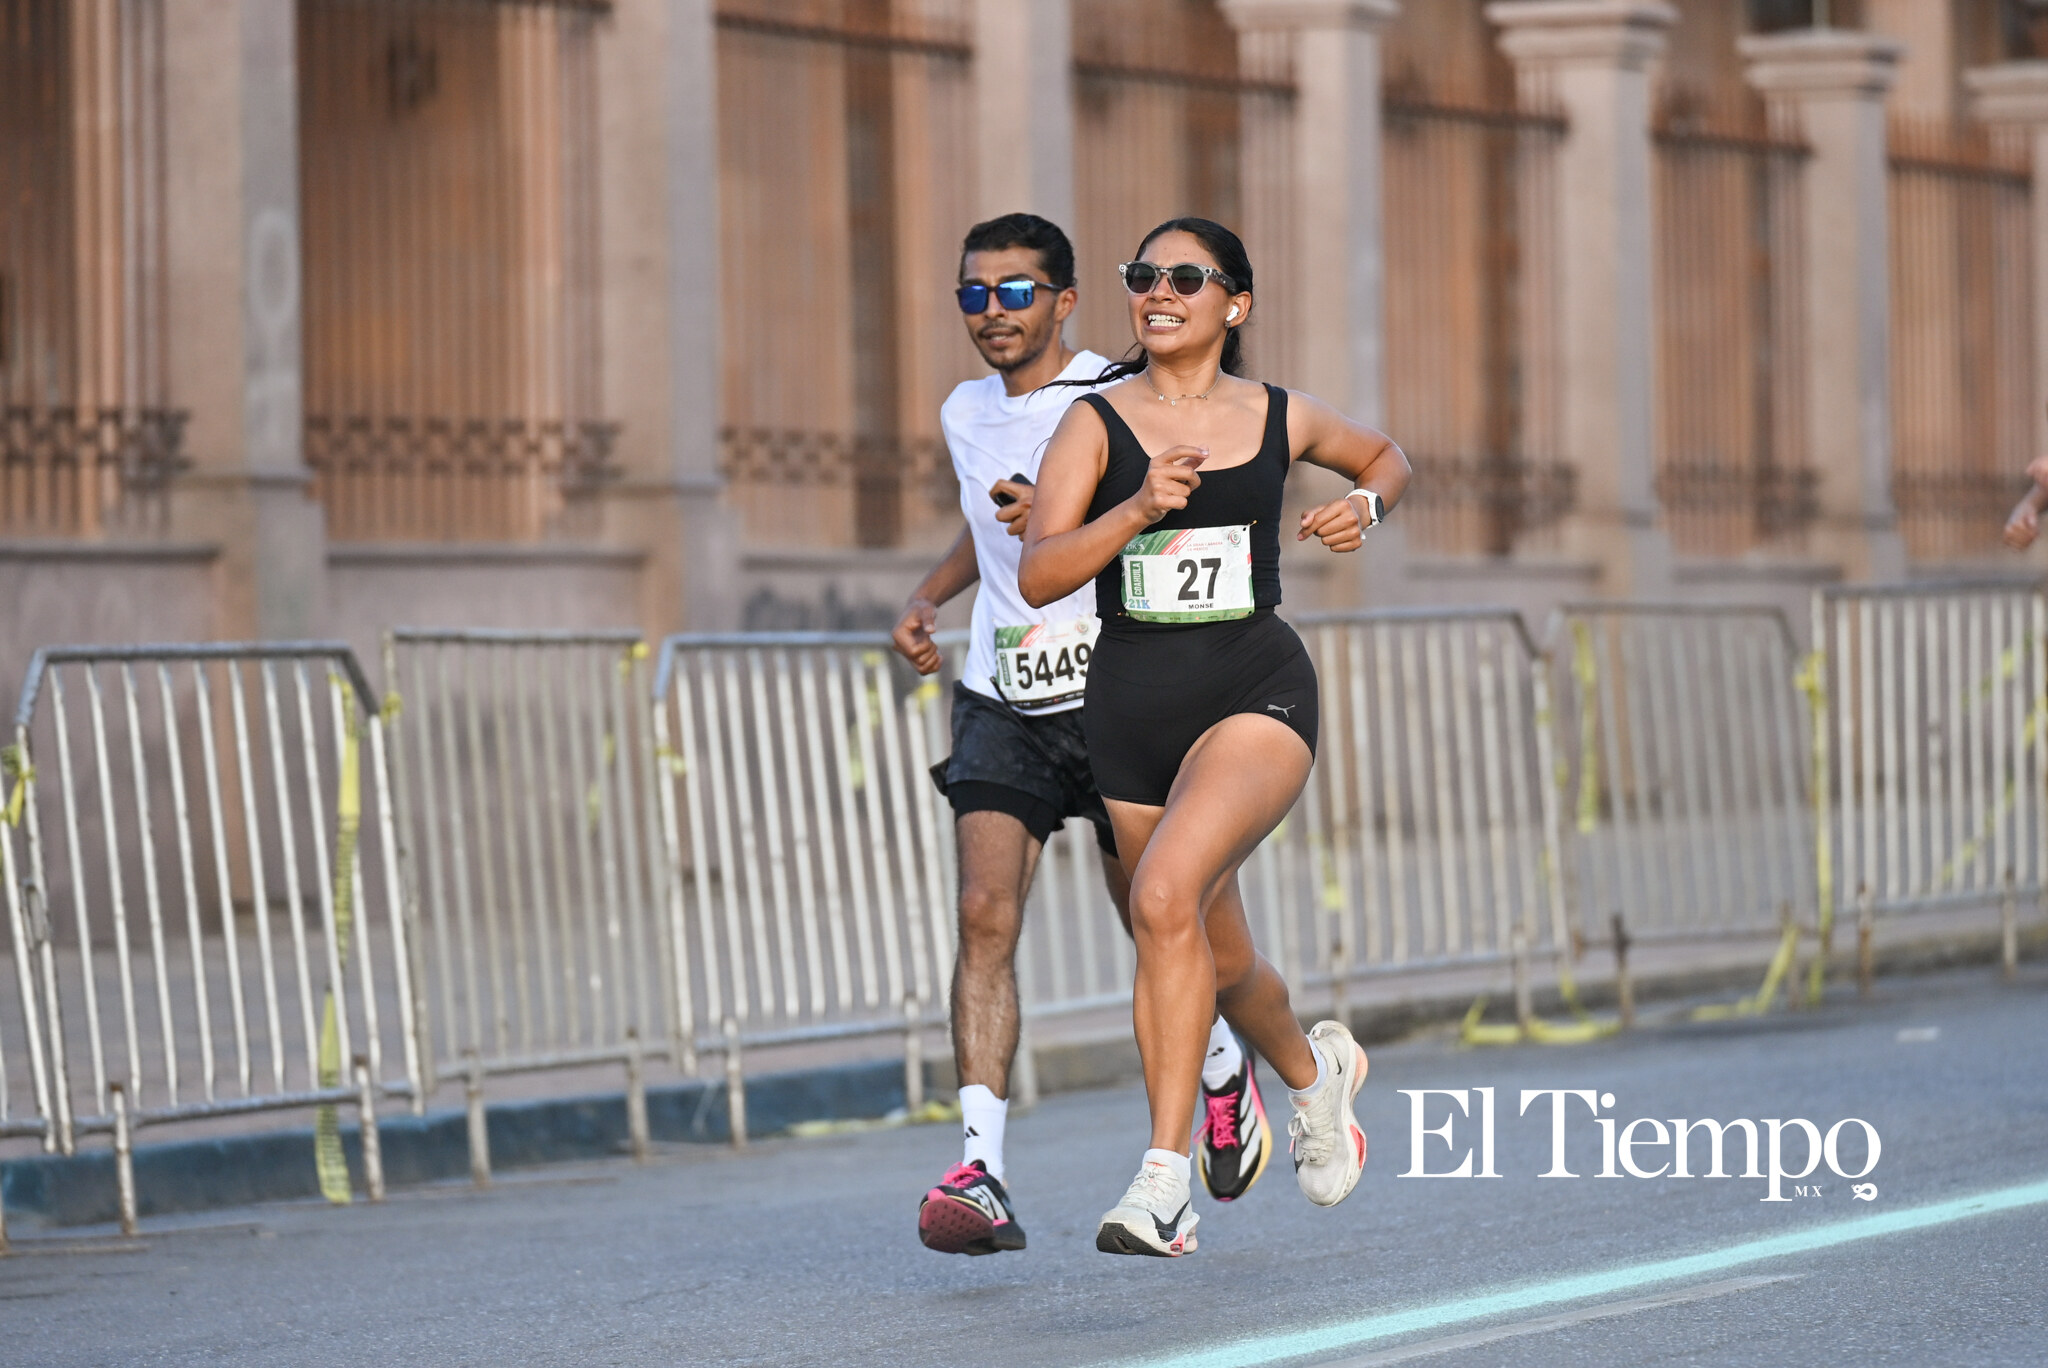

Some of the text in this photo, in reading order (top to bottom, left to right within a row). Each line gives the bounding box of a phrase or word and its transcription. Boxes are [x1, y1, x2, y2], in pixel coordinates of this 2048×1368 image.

[1132, 562, 1143, 596] COAHUILA
[1176, 557, 1222, 601] 27
[1128, 599, 1151, 609] 21K
[1016, 642, 1093, 690] 5449
